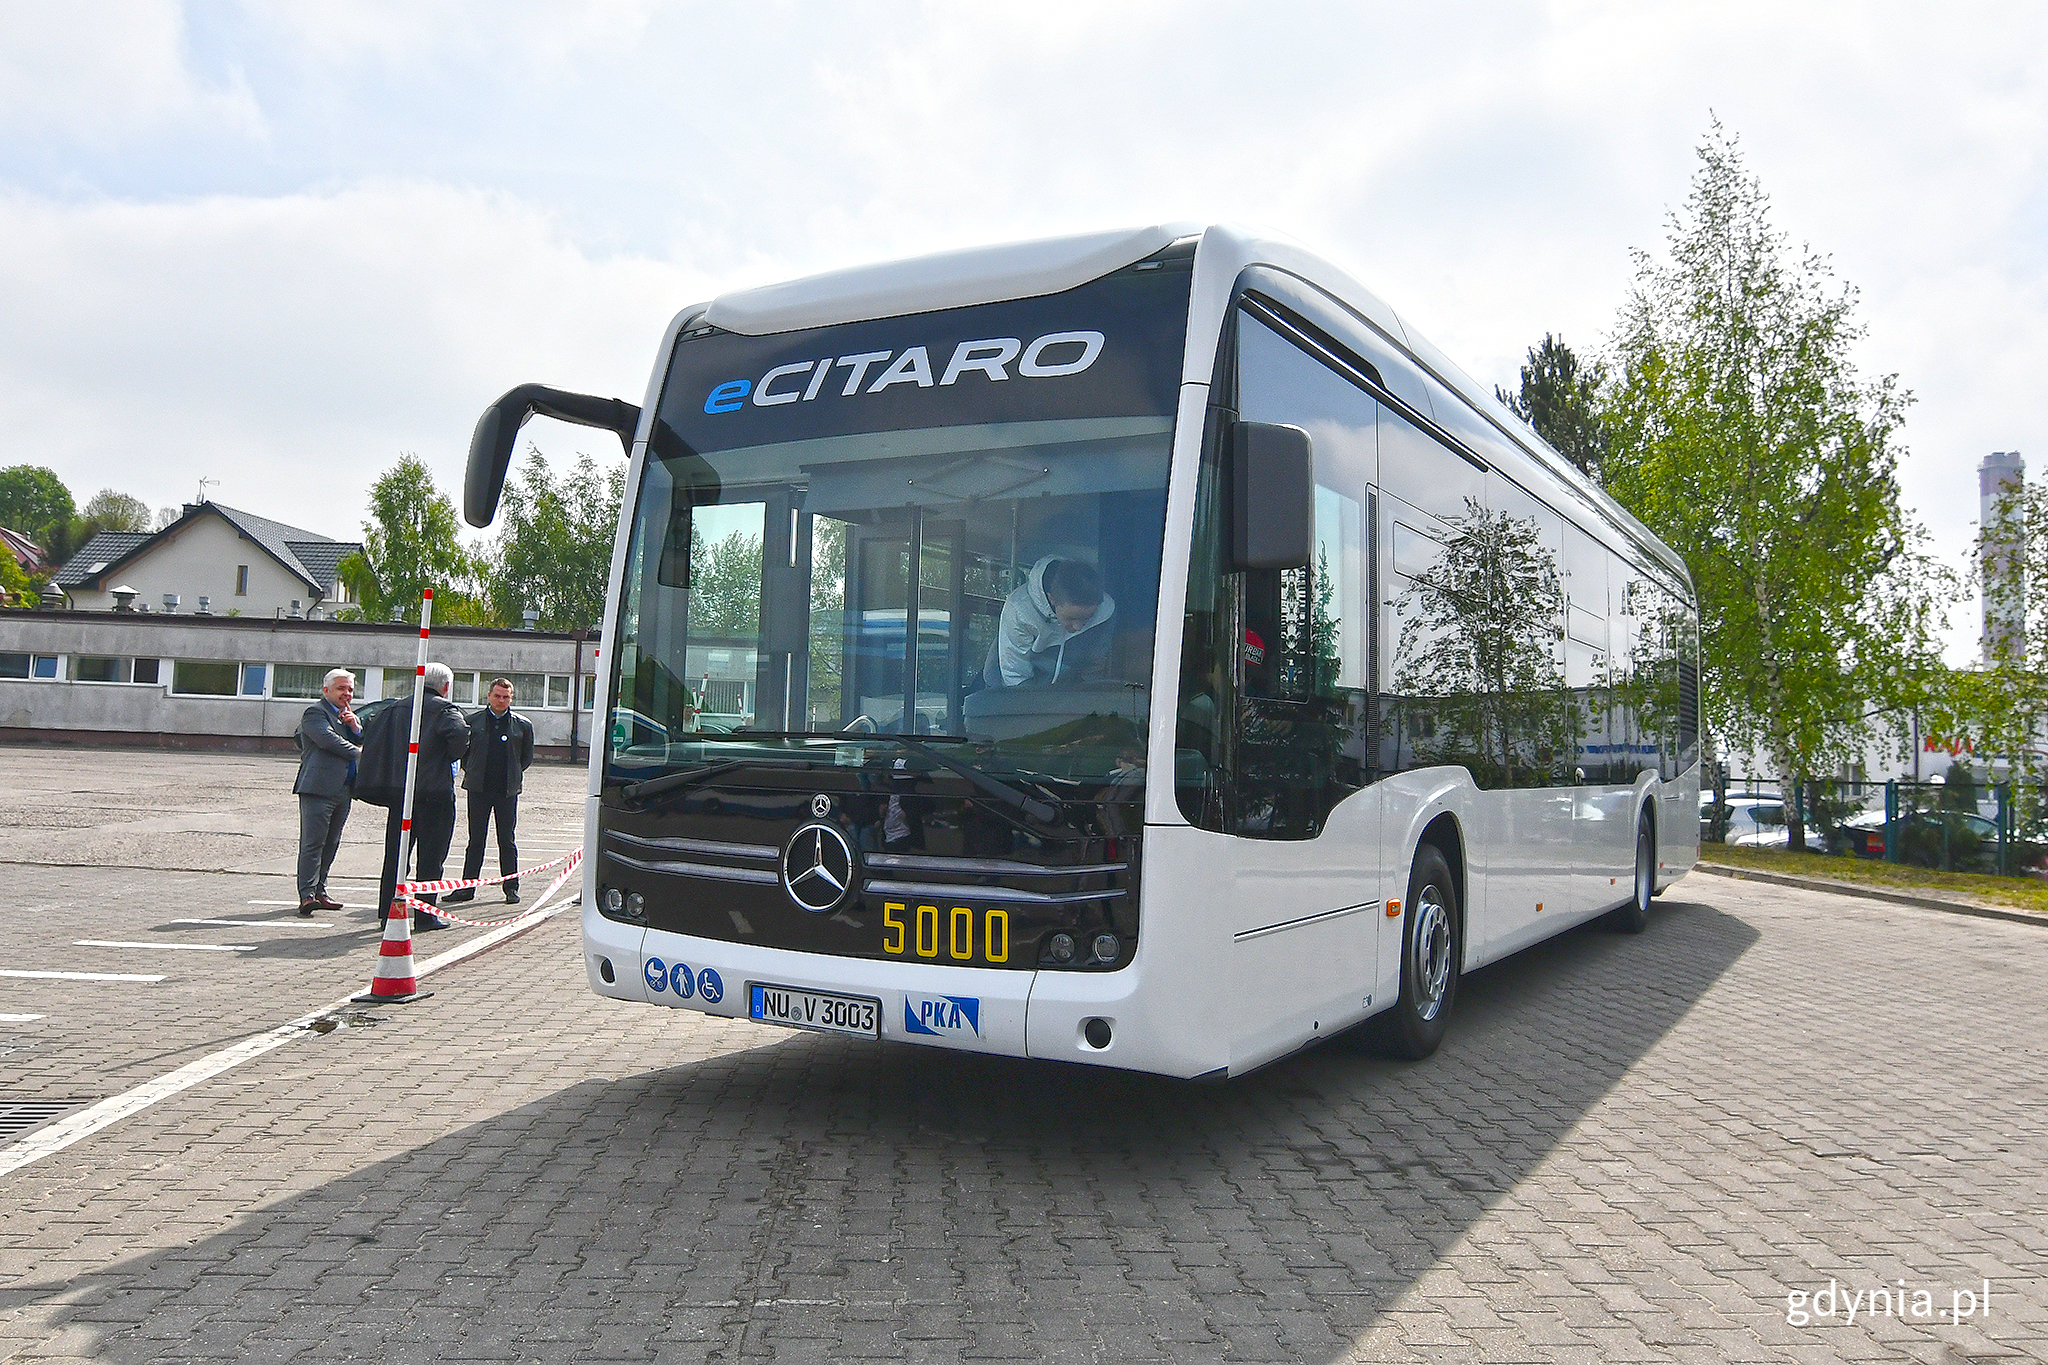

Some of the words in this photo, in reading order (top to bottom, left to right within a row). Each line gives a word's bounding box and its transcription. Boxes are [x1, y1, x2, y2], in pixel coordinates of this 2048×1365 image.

[704, 330, 1106, 414] eCITARO
[883, 901, 1009, 963] 5000
[754, 1005, 761, 1014] D
[763, 991, 790, 1018] NU
[804, 997, 817, 1021] V
[821, 999, 874, 1030] 3003
[921, 1000, 961, 1028] PKA
